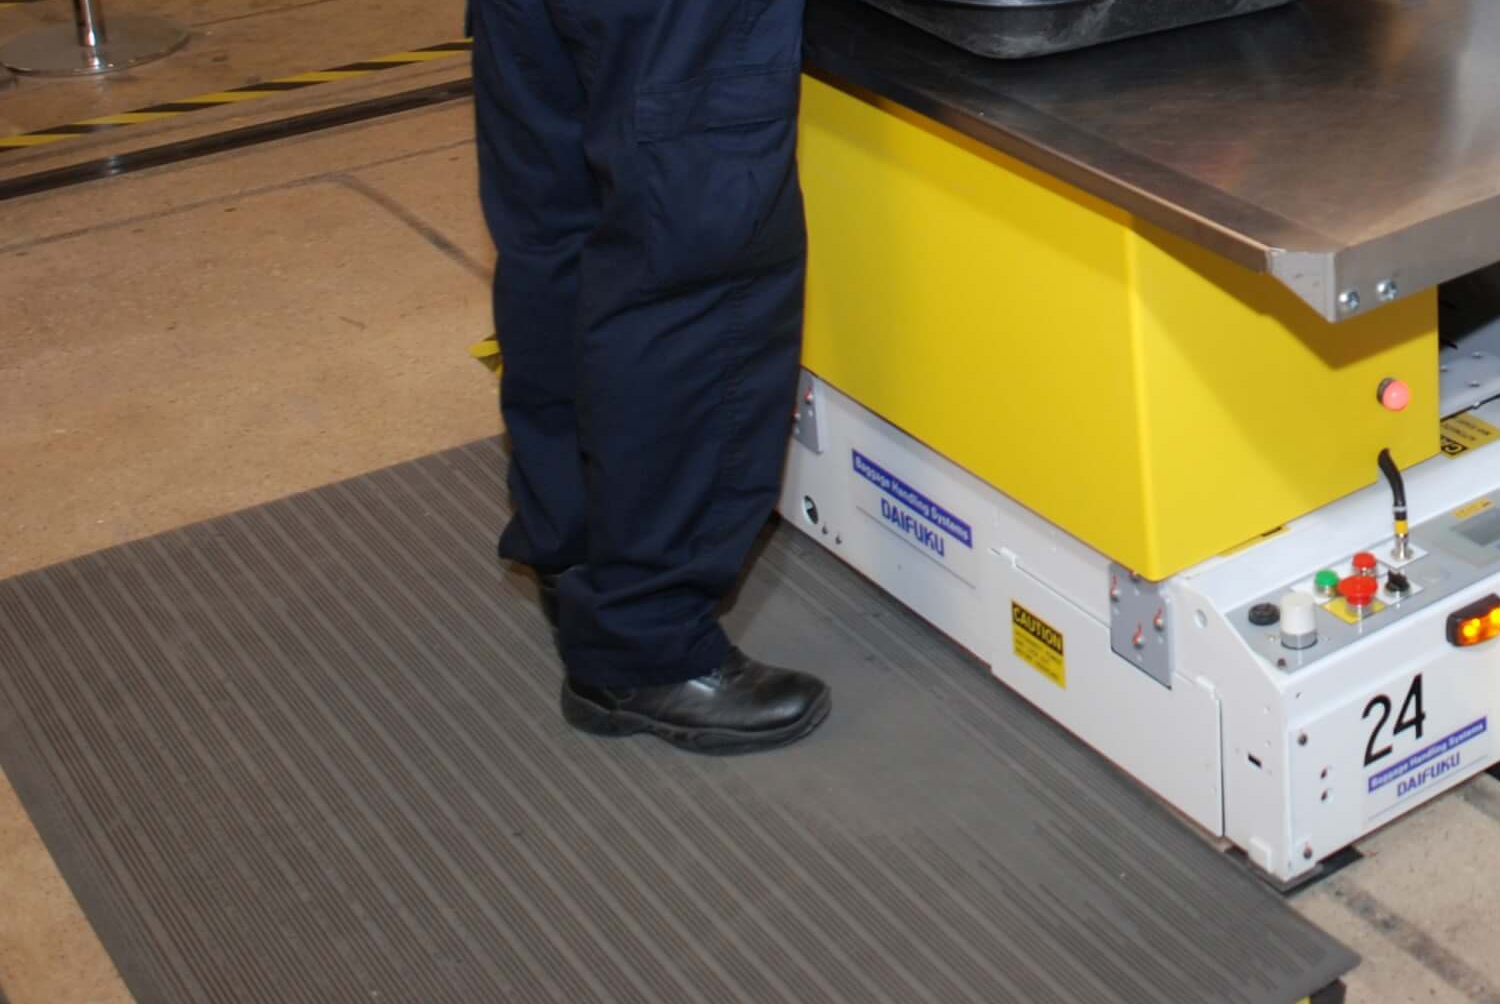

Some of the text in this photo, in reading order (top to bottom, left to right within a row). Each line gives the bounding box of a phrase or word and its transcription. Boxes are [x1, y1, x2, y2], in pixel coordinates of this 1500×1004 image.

[856, 456, 969, 541] Baggage Handling Systems
[881, 497, 944, 557] DAIFUKU
[1014, 606, 1063, 653] CAUTION
[1362, 673, 1426, 767] 24
[1371, 723, 1485, 788] Baggage Handling Systems
[1397, 752, 1460, 797] DAIFUKU
